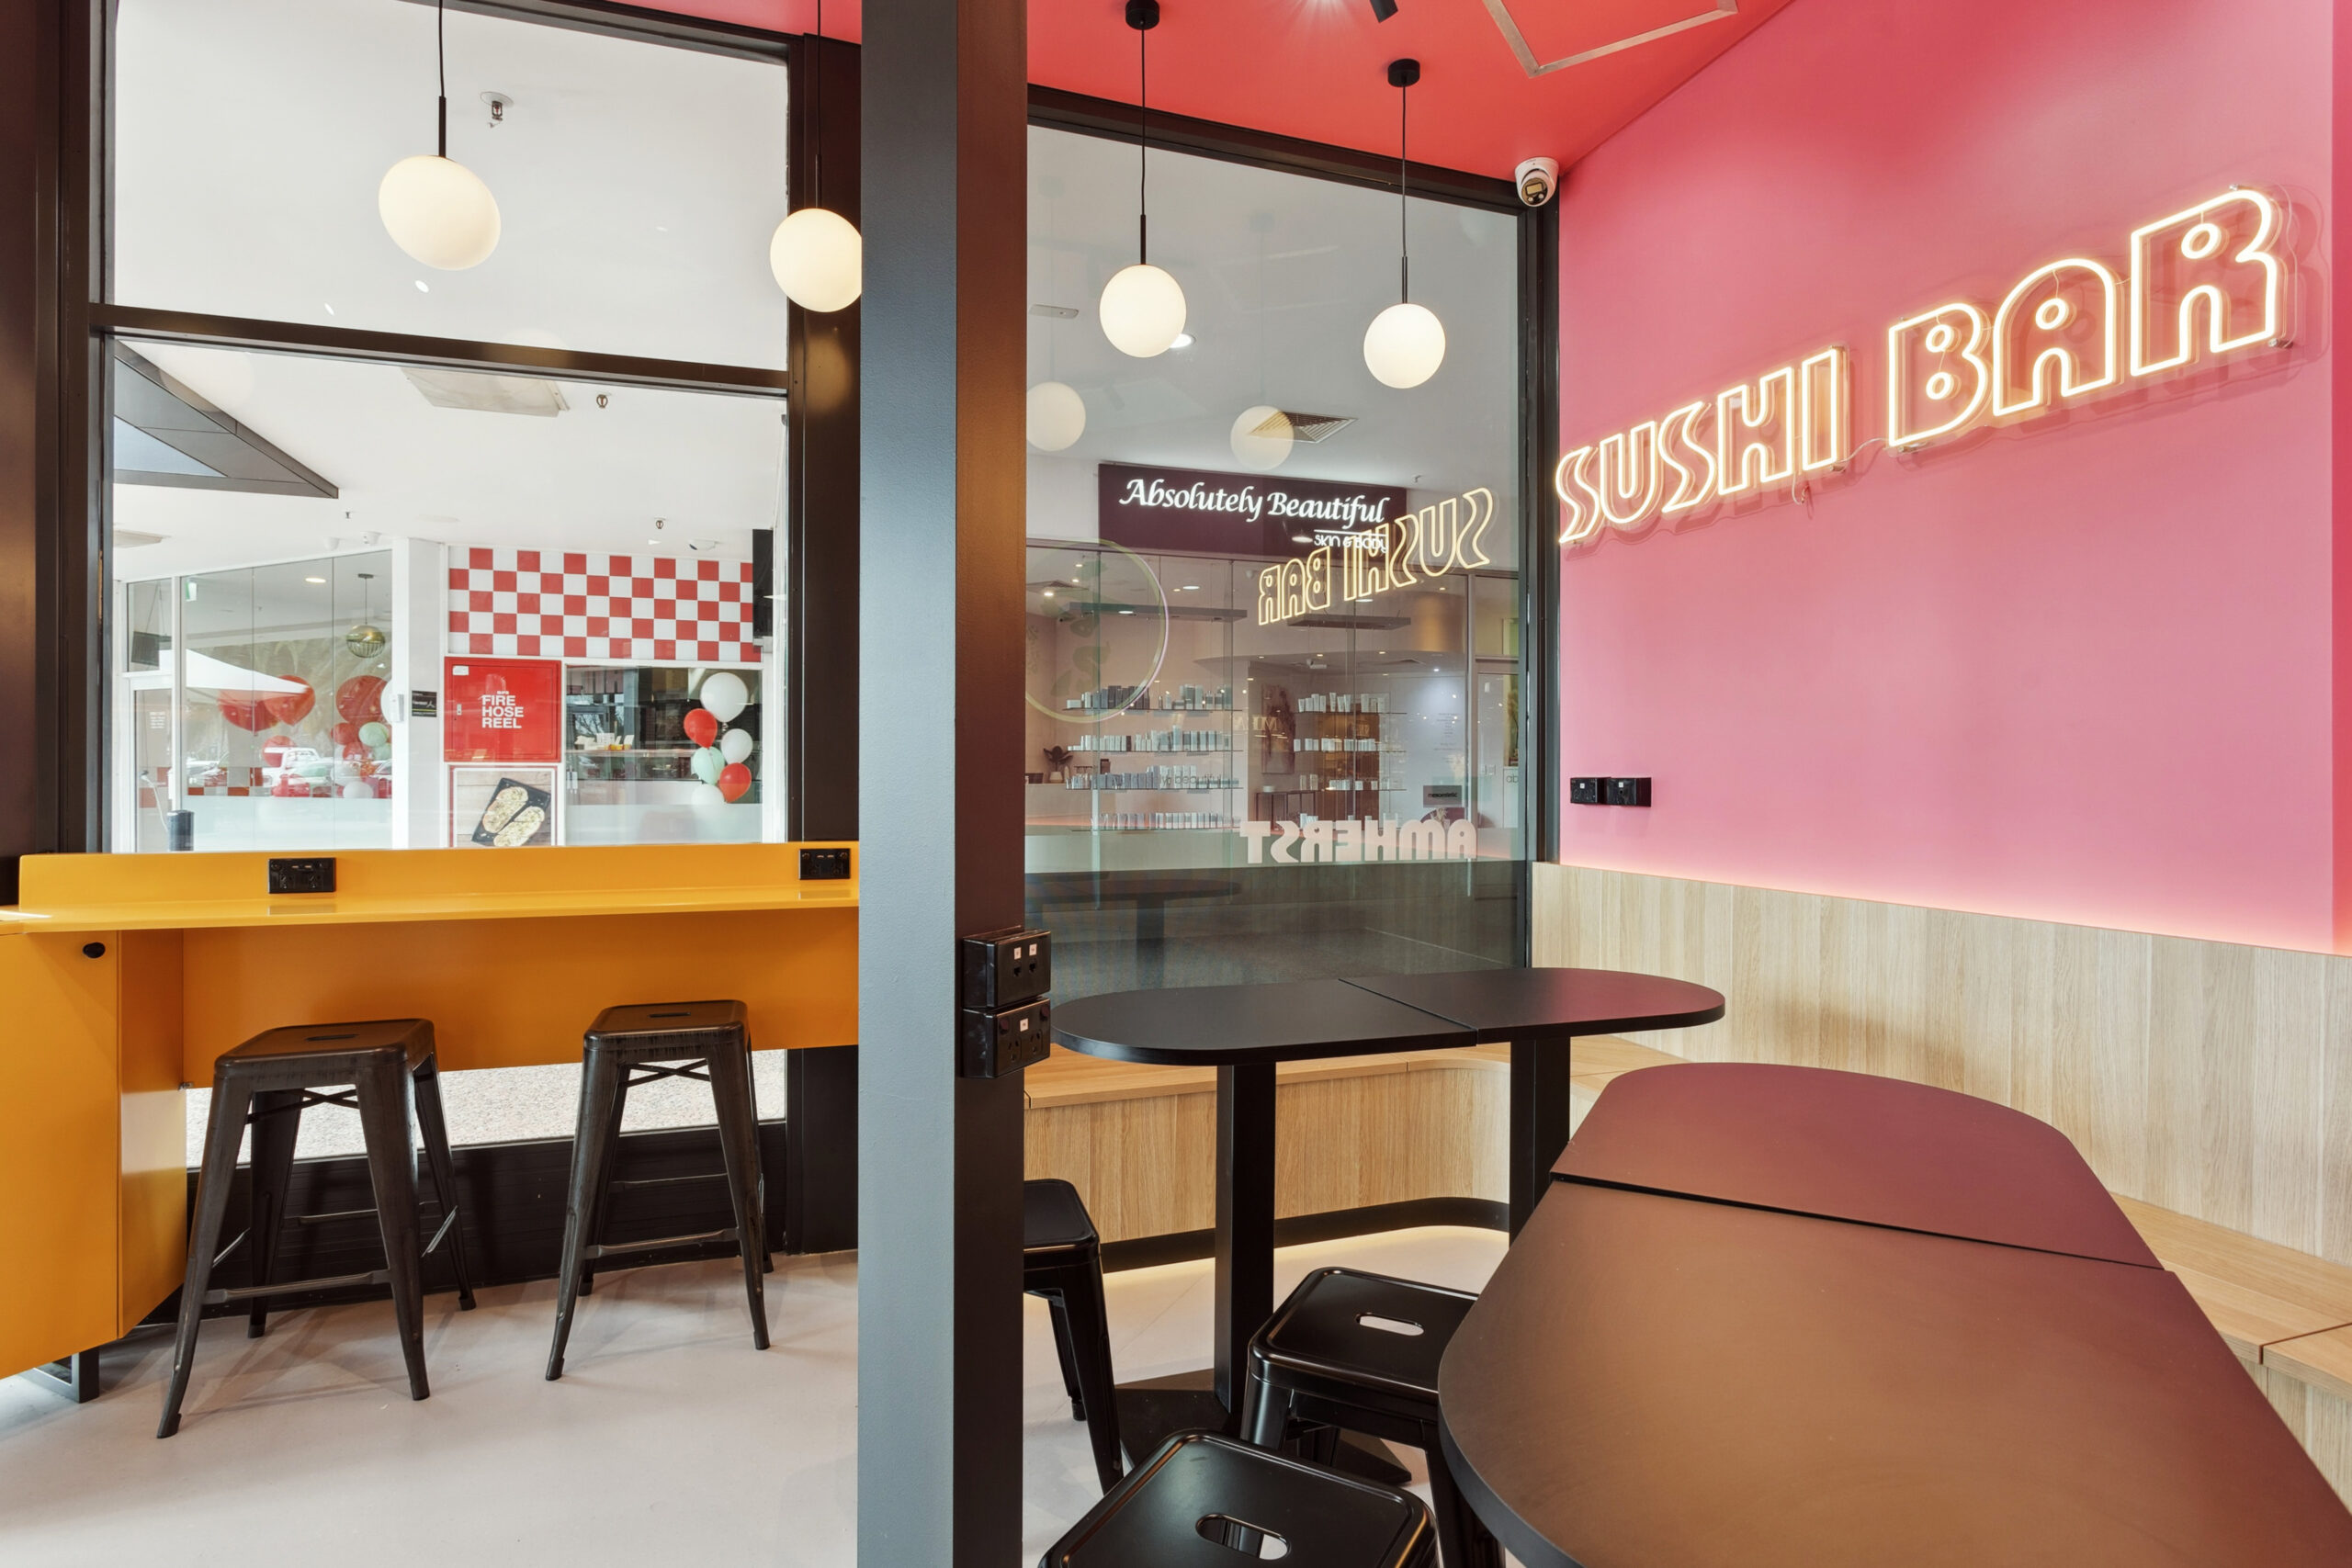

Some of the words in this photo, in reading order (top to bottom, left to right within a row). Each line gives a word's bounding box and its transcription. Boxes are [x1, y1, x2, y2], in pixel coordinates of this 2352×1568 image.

[1555, 347, 1840, 545] SUSHI
[1887, 188, 2280, 448] BAR
[1118, 478, 1263, 523] Absolutely
[1266, 491, 1390, 530] Beautiful
[481, 694, 516, 706] FIRE
[481, 706, 525, 717] HOSE
[481, 717, 522, 728] REEL
